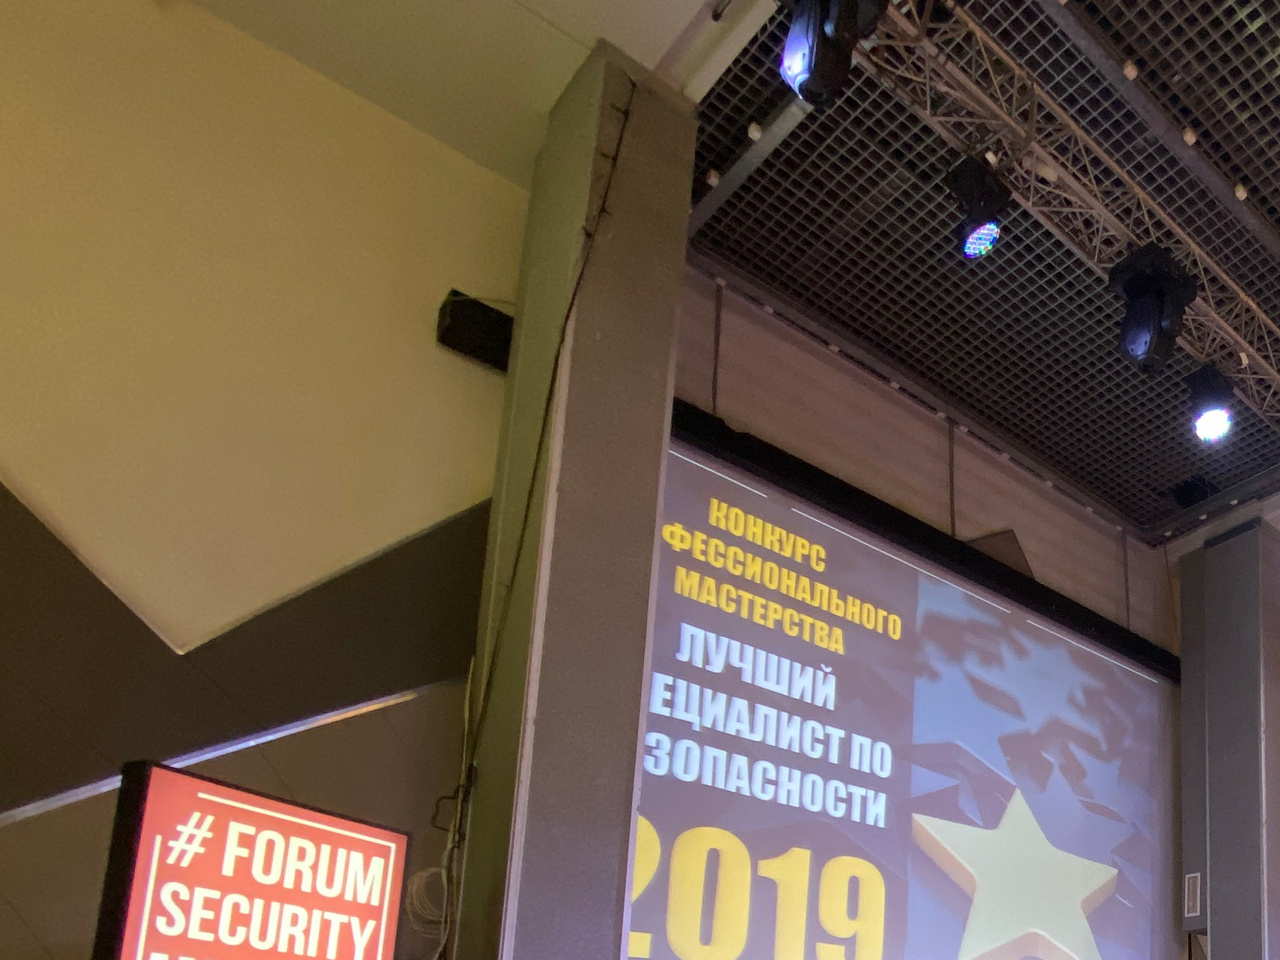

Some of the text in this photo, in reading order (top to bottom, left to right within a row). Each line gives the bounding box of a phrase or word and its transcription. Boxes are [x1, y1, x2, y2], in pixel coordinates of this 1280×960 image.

[708, 497, 826, 572] КОНКУРС
[673, 565, 845, 656] МАСТЕРСТВА
[675, 621, 837, 711] ЛУЧШИЙ
[849, 733, 892, 779] ПО
[166, 811, 385, 906] # FORUM
